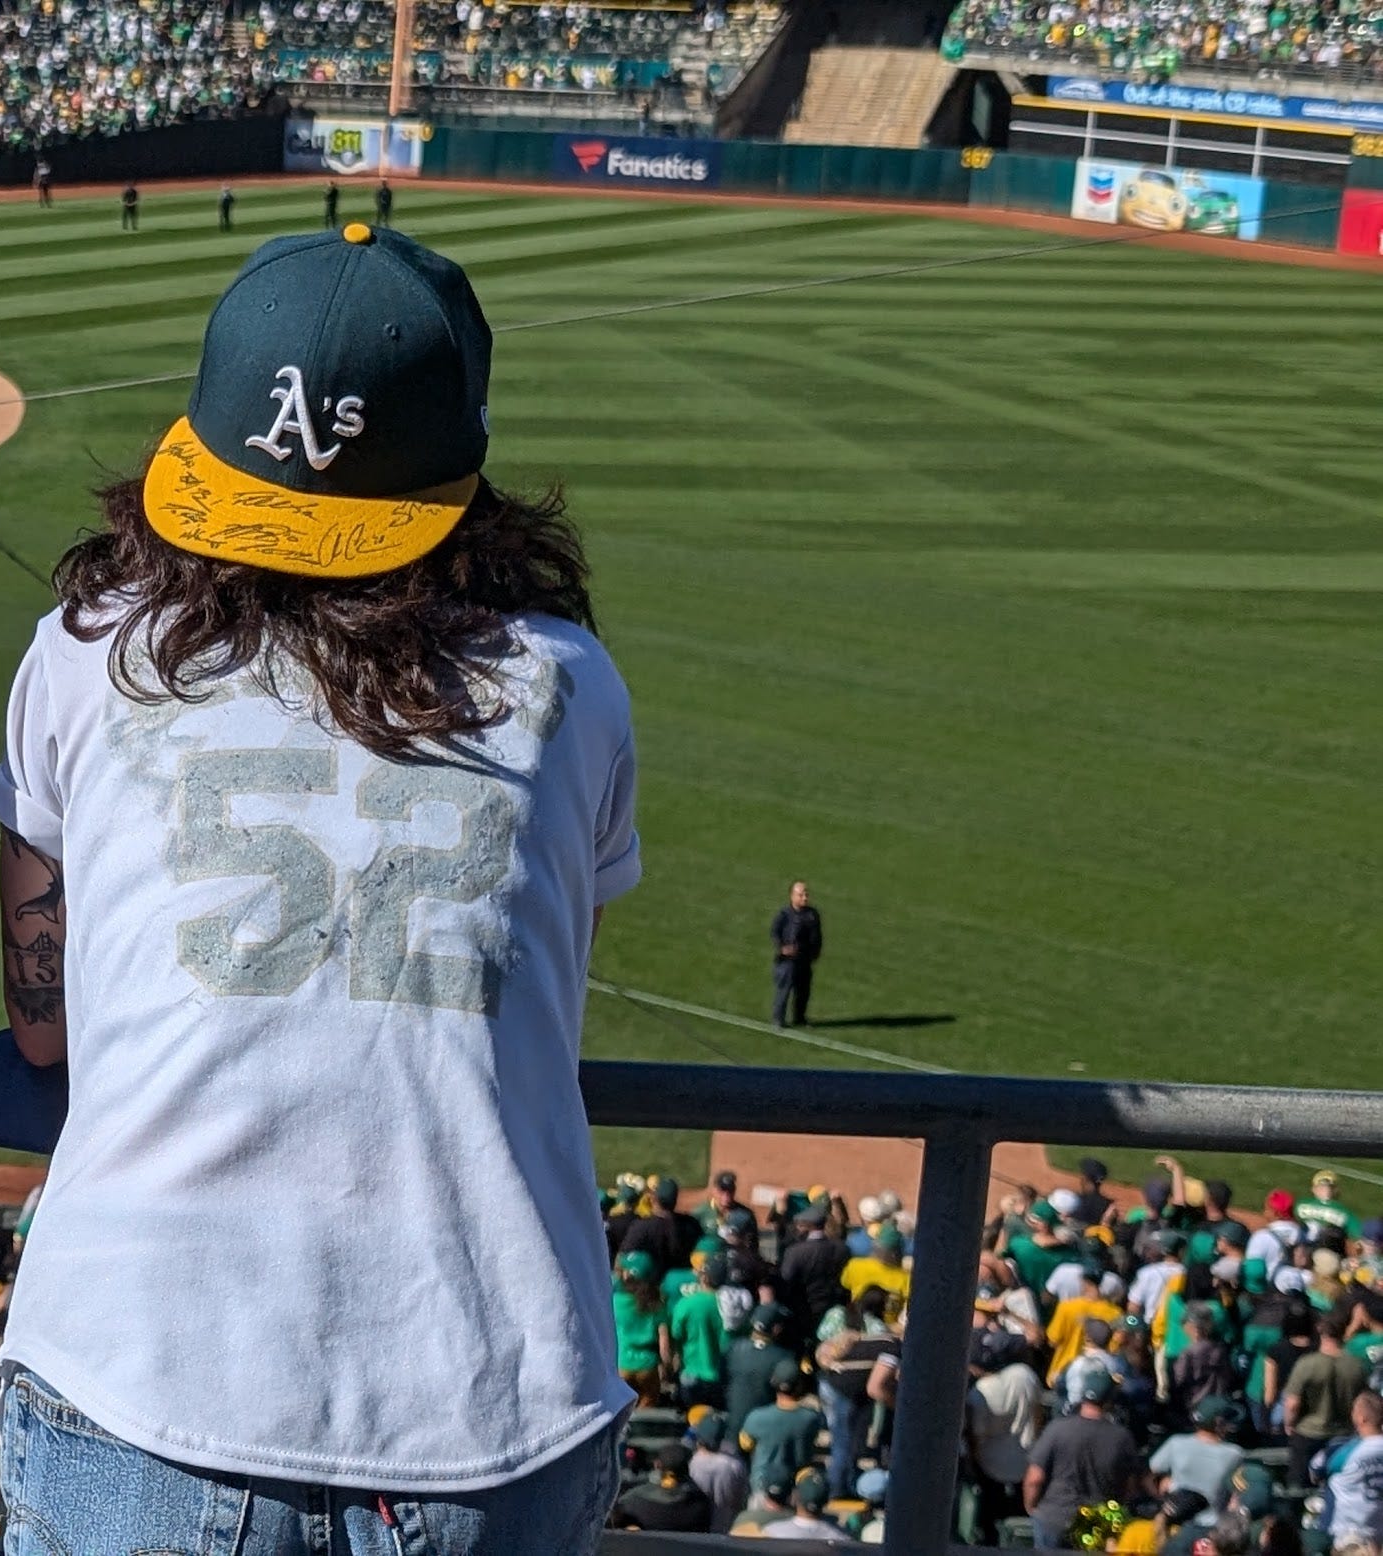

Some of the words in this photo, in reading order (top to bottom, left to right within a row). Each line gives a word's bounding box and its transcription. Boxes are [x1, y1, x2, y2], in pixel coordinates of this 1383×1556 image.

[606, 148, 708, 181] Fanatics
[244, 365, 367, 471] A's
[174, 746, 515, 1019] 52
